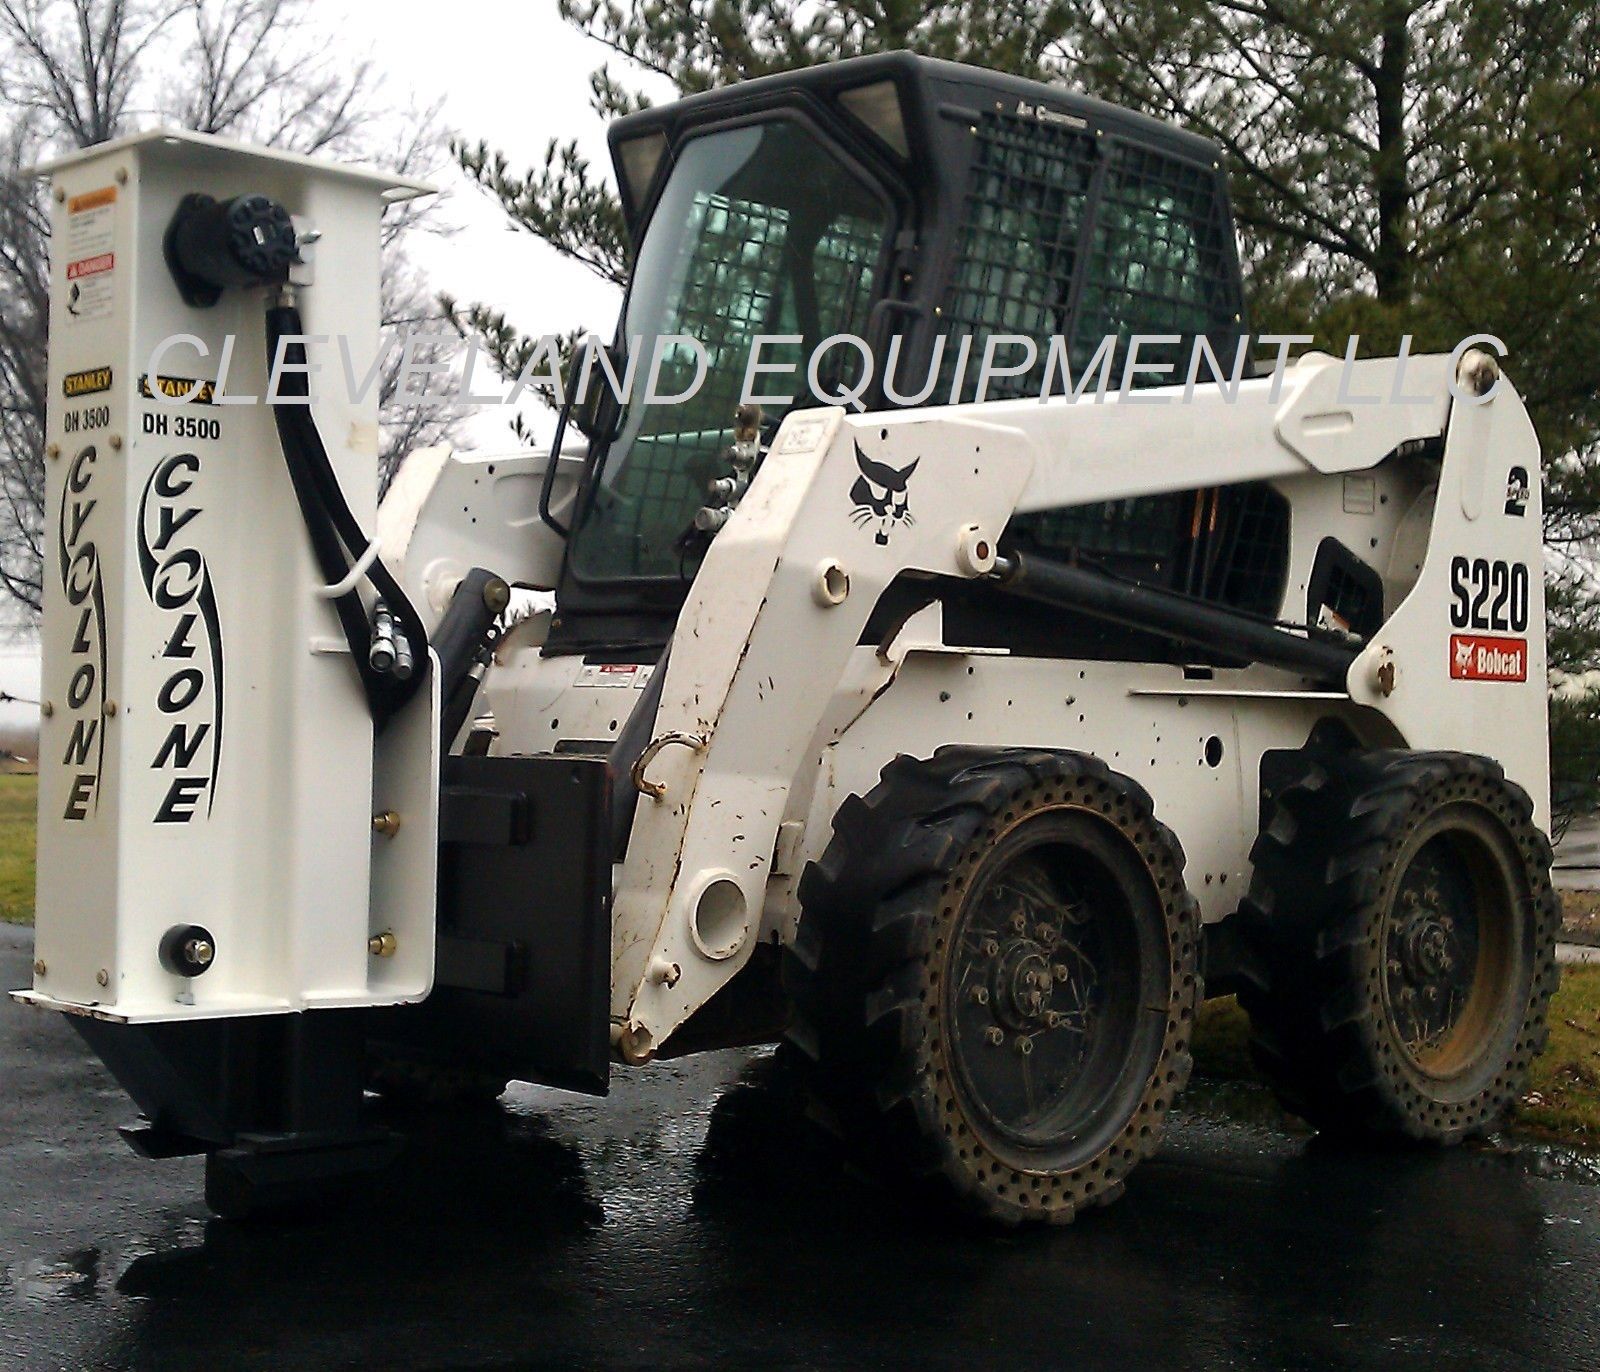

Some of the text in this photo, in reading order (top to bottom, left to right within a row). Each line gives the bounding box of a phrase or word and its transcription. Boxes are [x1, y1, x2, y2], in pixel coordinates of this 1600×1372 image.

[66, 370, 110, 394] STANLEY
[64, 406, 109, 432] DH 3500
[143, 413, 221, 439] DH 3500
[1505, 466, 1528, 517] 2
[1450, 556, 1528, 632] S220
[1477, 646, 1521, 676] Bobcat
